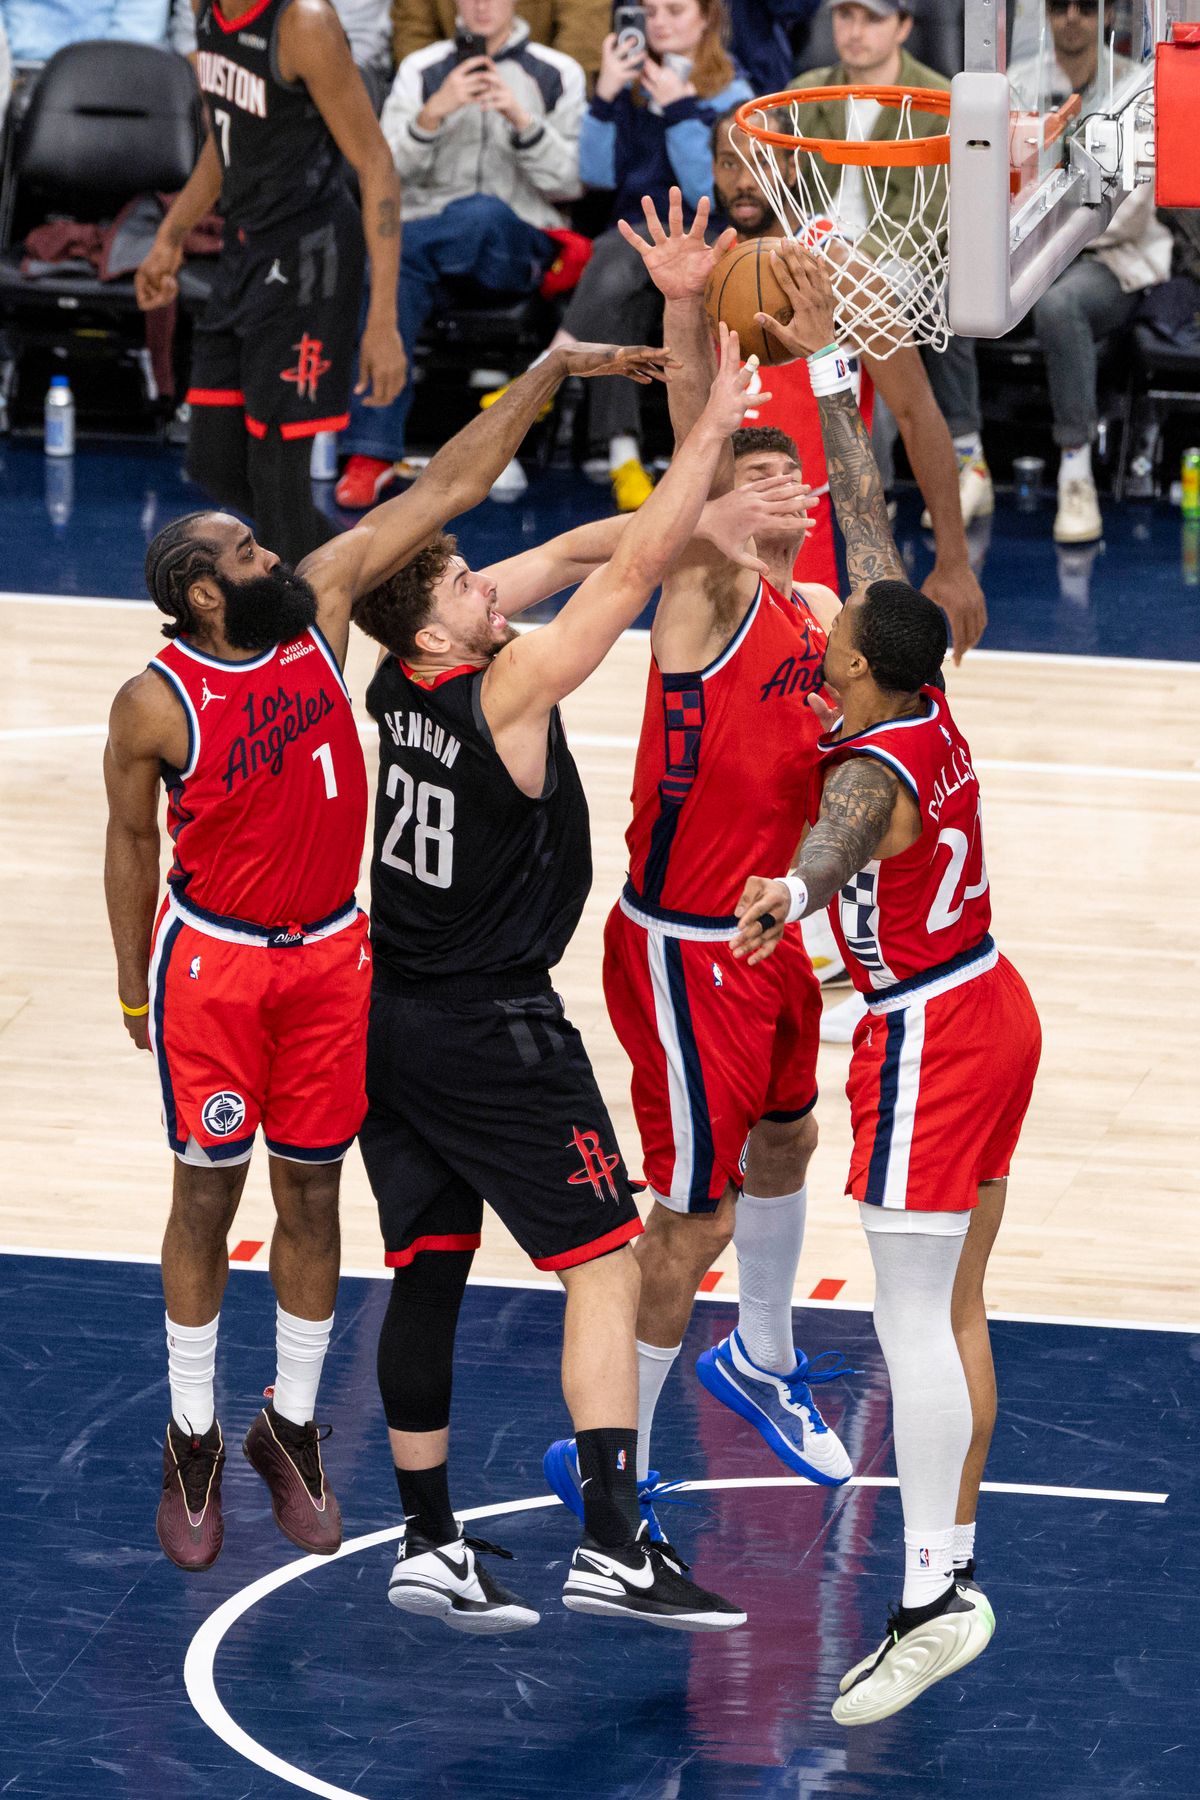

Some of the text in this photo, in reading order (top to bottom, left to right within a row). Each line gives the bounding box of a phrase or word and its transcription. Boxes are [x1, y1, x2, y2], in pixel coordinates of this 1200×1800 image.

[196, 50, 267, 118] OUSTON
[214, 108, 231, 167] 7
[279, 644, 316, 666] RWANDA
[283, 641, 304, 655] VISIT
[222, 688, 335, 794] Angeles
[242, 686, 294, 738] Los
[384, 711, 462, 769] SENGUN
[312, 742, 338, 800] 1
[381, 763, 455, 889] 28
